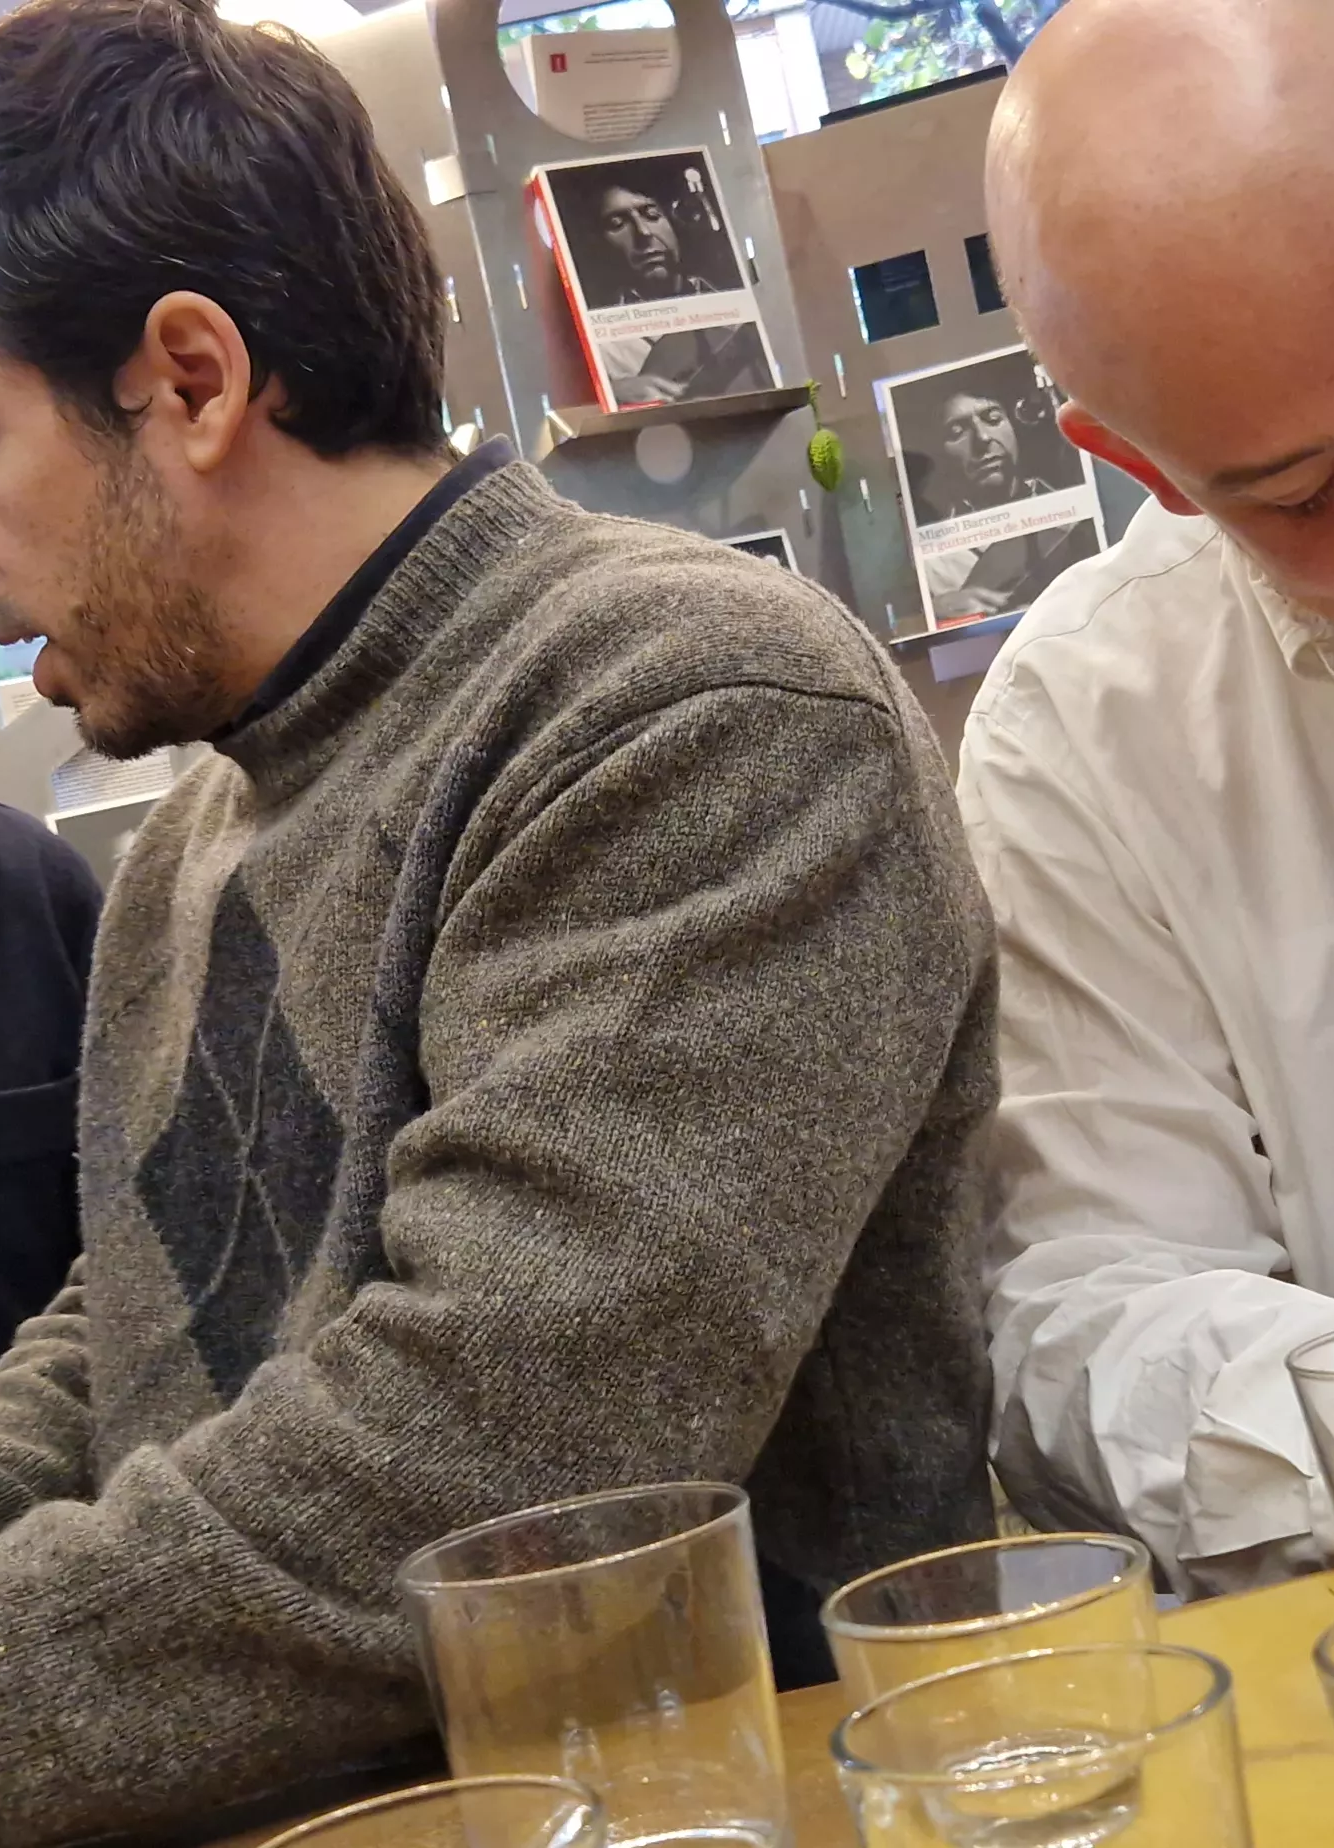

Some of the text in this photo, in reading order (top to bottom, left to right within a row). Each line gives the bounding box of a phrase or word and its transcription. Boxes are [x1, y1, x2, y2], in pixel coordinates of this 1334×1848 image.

[589, 304, 678, 326] Miguel Barrero
[594, 308, 741, 339] El guitarrista de Montreal
[918, 511, 1010, 544] Miguel Barrero
[920, 505, 1077, 555] El guitarrista de Montreal
